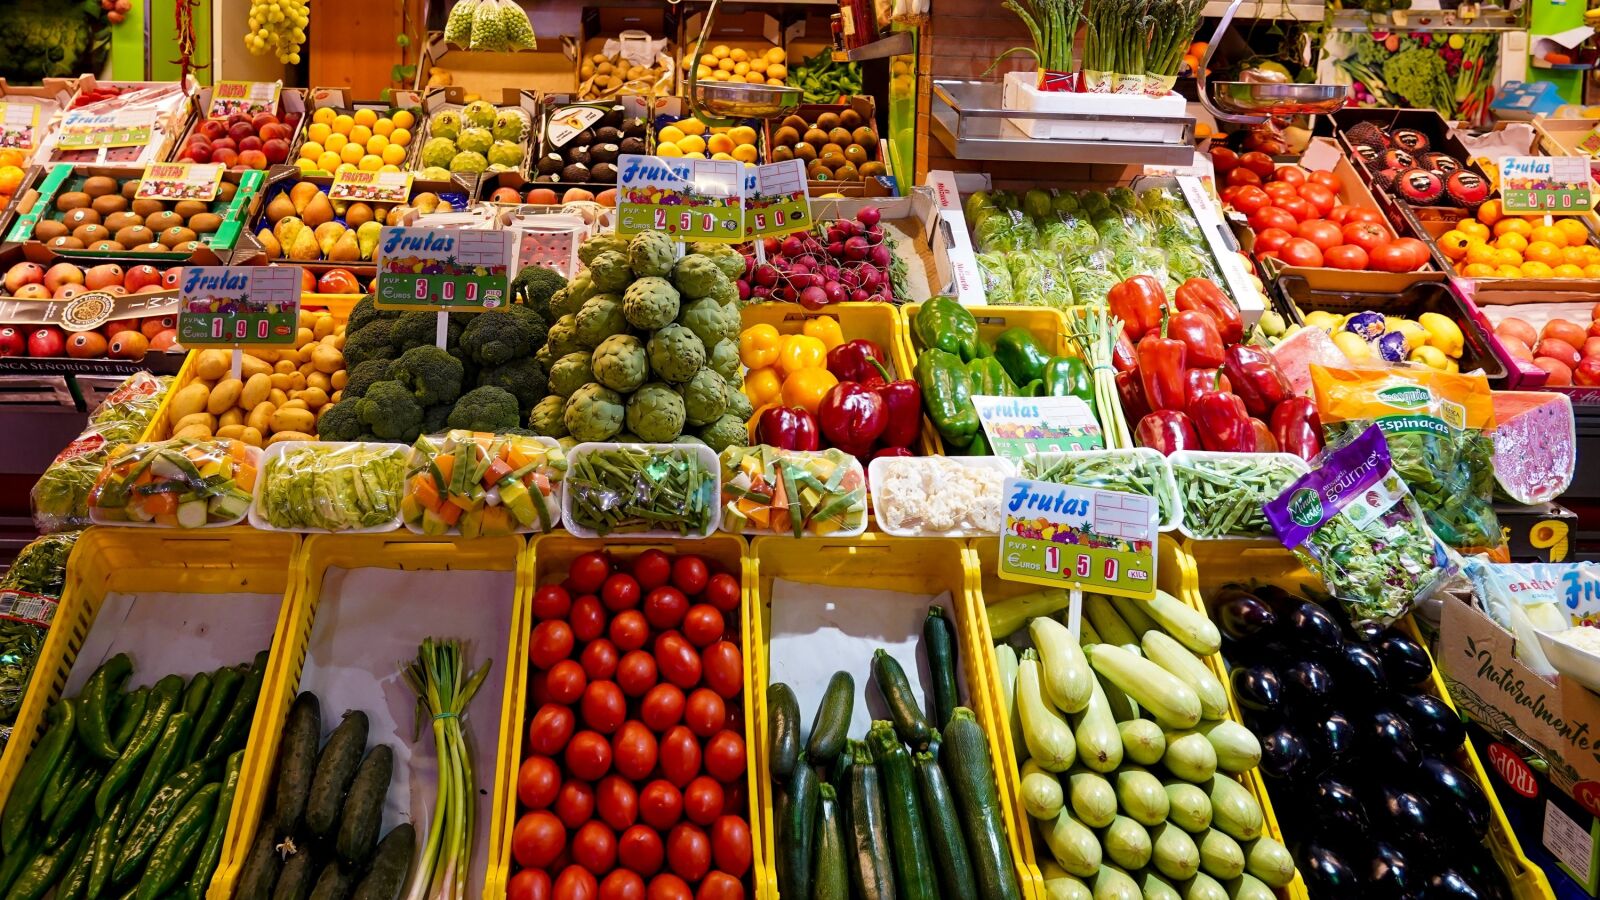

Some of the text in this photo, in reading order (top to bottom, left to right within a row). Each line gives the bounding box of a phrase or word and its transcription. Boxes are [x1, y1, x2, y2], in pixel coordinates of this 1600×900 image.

[65, 114, 116, 125] Frutas
[623, 156, 690, 183] Frutas
[1504, 157, 1550, 176] Frutas
[384, 228, 454, 253] Frutas
[184, 267, 248, 293] Frutas
[0, 362, 28, 370] NCA
[1377, 418, 1449, 434] Espinacas
[1009, 481, 1089, 517] Frutas
[1295, 503, 1322, 524] Verde
[1477, 650, 1590, 750] Naturalmente
[1488, 744, 1535, 794] TROPS
